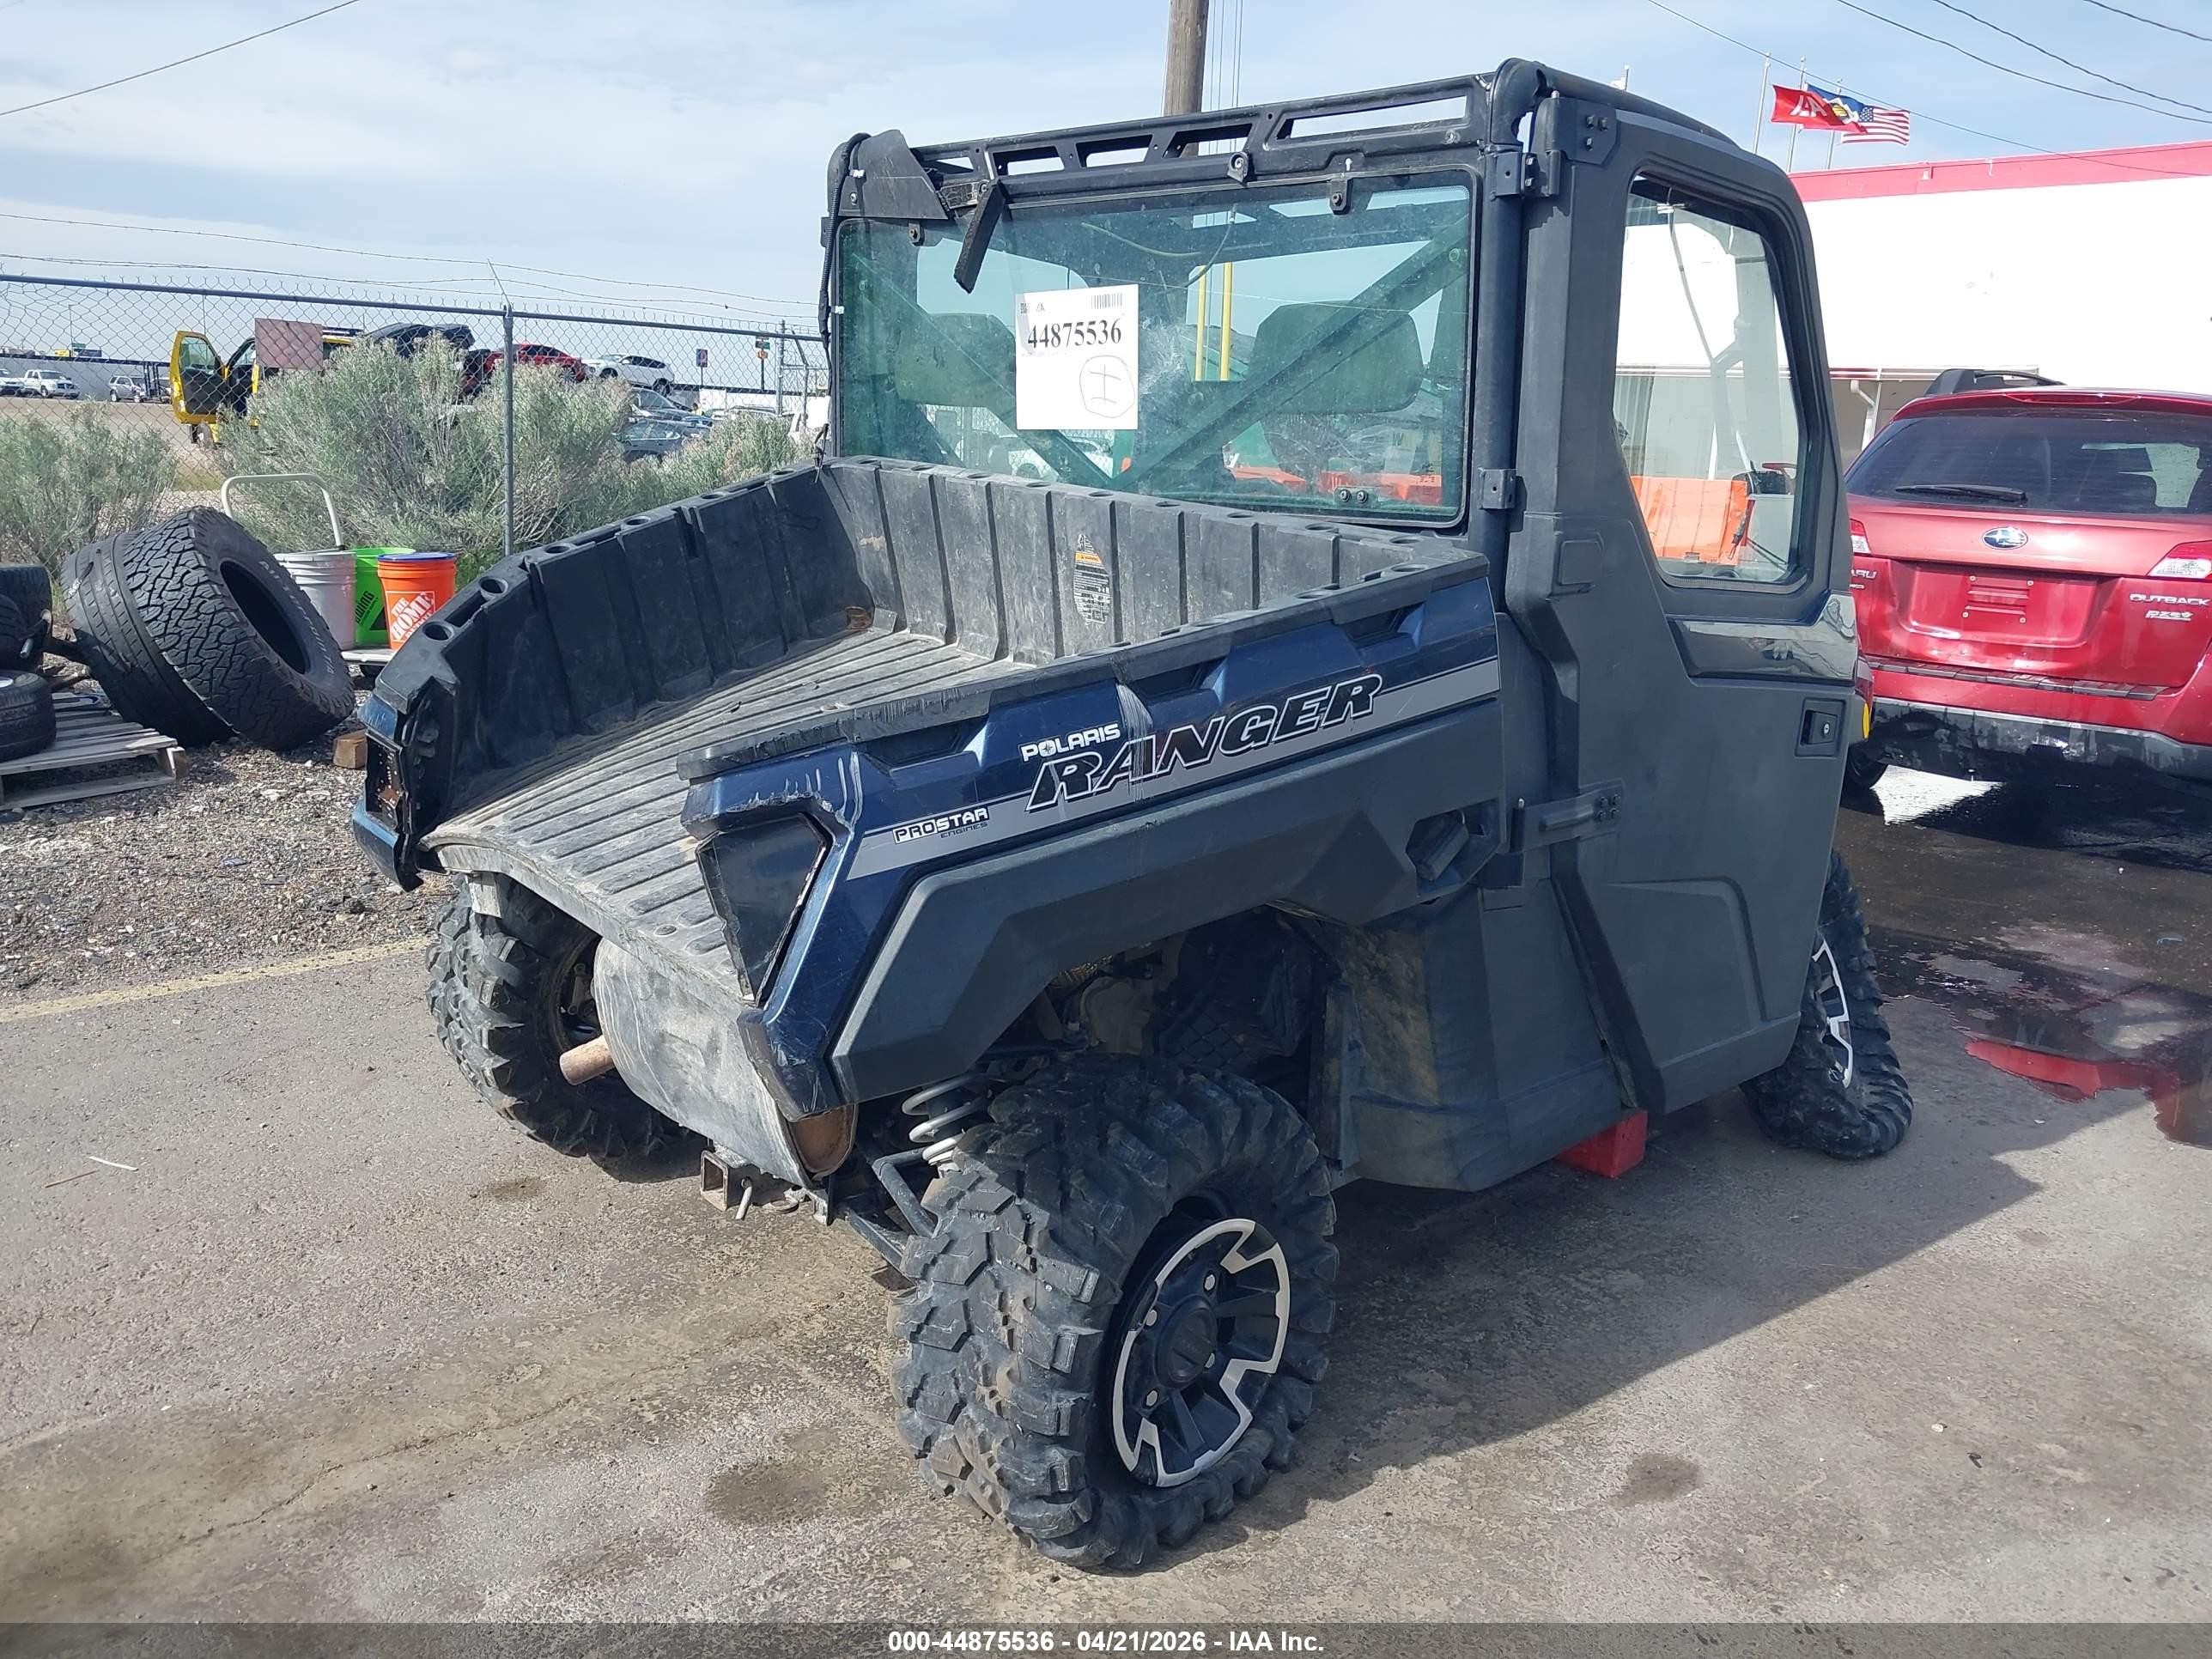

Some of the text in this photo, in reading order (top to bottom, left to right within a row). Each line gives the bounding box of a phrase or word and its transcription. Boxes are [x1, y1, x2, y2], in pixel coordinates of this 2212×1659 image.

[1028, 318, 1121, 349] 44875536
[391, 598, 410, 617] THE
[2130, 593, 2210, 605] OUTBACK
[391, 592, 434, 641] HOME
[1020, 723, 1121, 762] POLARIS
[1025, 674, 1382, 811] RANGER
[894, 808, 988, 842] PROSTAR
[940, 822, 988, 838] ENGINES
